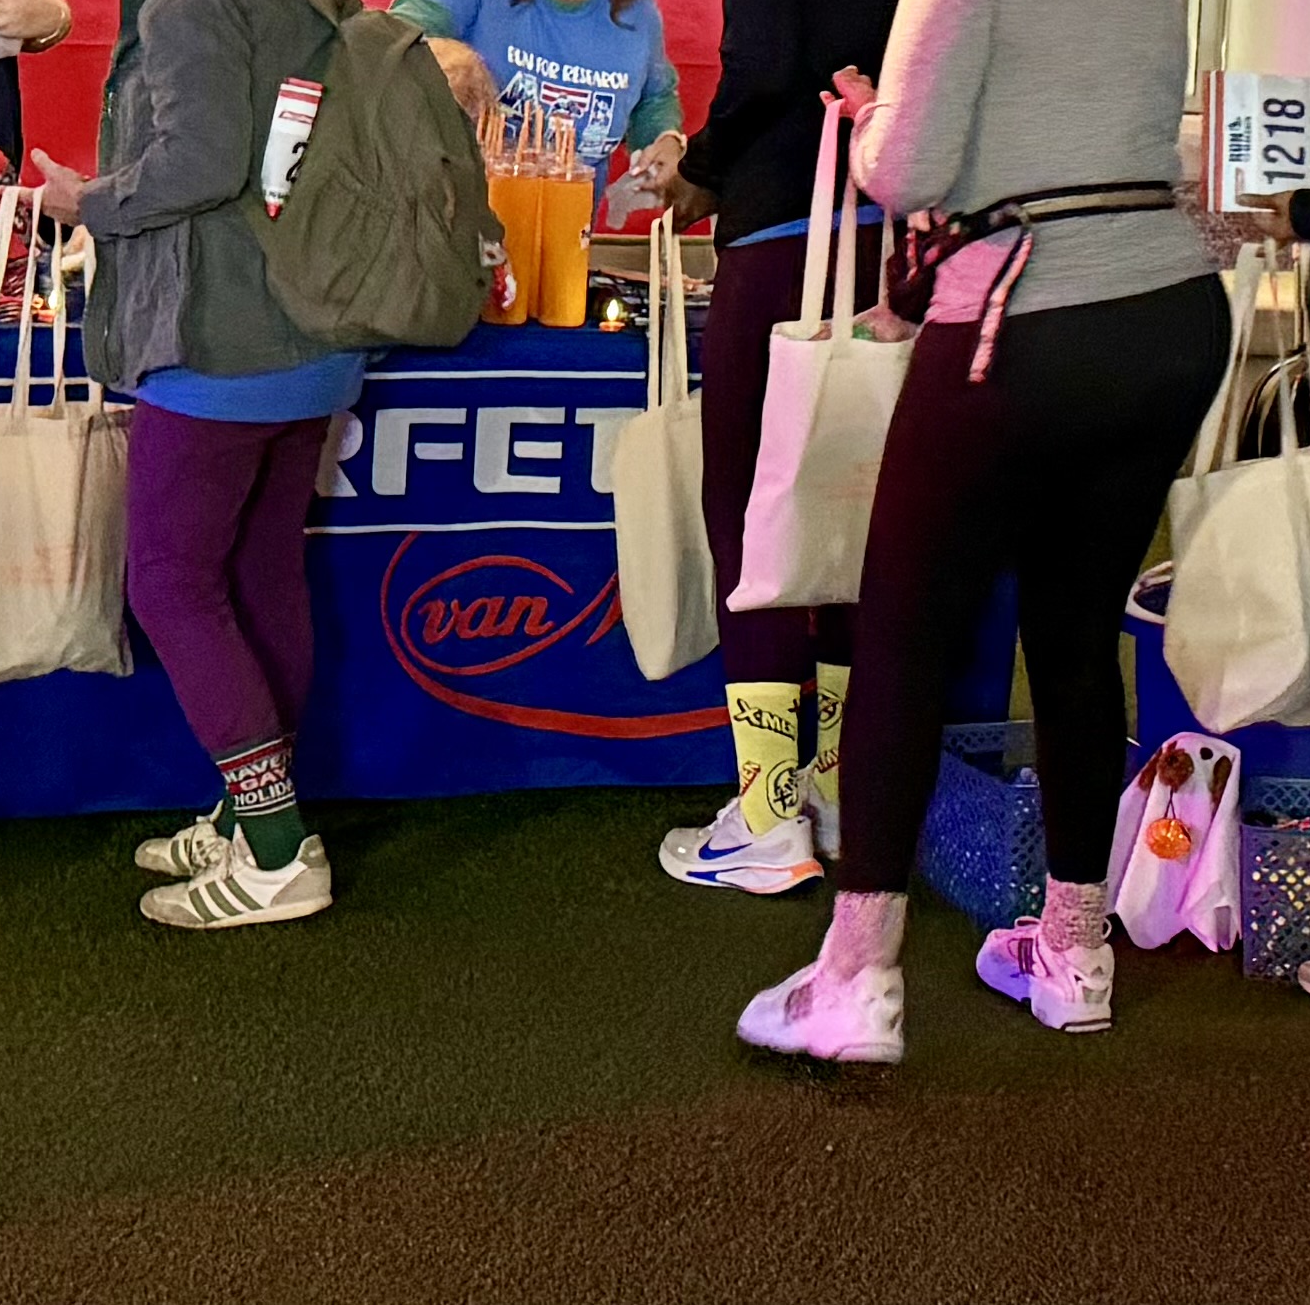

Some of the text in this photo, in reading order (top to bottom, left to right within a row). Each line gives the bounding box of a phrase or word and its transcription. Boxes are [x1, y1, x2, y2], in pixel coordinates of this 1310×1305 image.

[1263, 98, 1306, 185] 1218
[418, 596, 554, 645] van
[223, 755, 282, 783] HAVE
